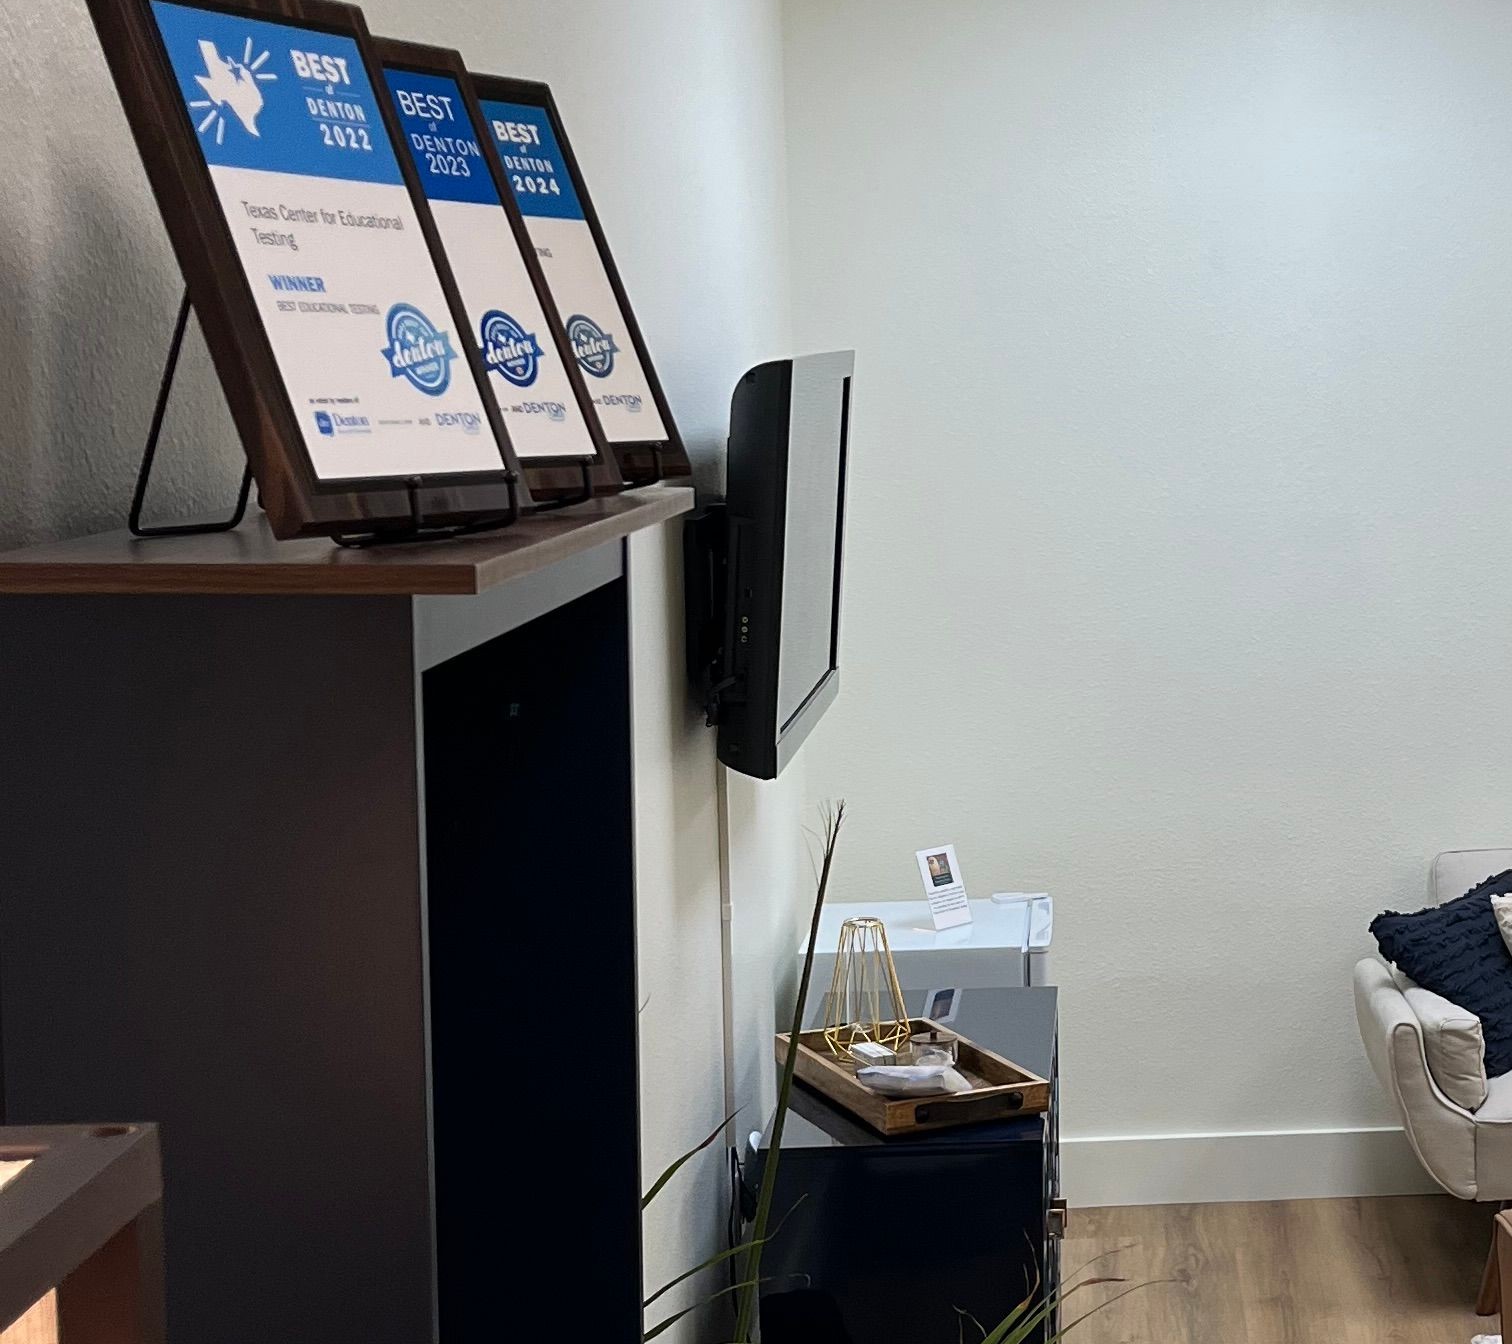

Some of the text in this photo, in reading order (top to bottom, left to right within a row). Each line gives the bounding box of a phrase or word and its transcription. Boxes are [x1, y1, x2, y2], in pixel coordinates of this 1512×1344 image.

[290, 49, 351, 86] BEST
[305, 96, 367, 123] DENTON
[396, 89, 455, 122] BEST
[320, 123, 373, 151] 2022
[491, 119, 540, 145] BEST
[410, 133, 480, 157] DENTON
[425, 153, 471, 177] 2023
[503, 155, 554, 173] DENTON
[512, 175, 560, 196] 2024
[241, 200, 405, 231] Texas Center for Educational
[250, 227, 299, 251] Testing
[268, 274, 327, 294] WINNER
[392, 336, 447, 368] denton
[486, 337, 534, 364] denton
[522, 402, 567, 414] DENTON
[602, 395, 642, 406] DENTON
[435, 412, 482, 427] DENTON
